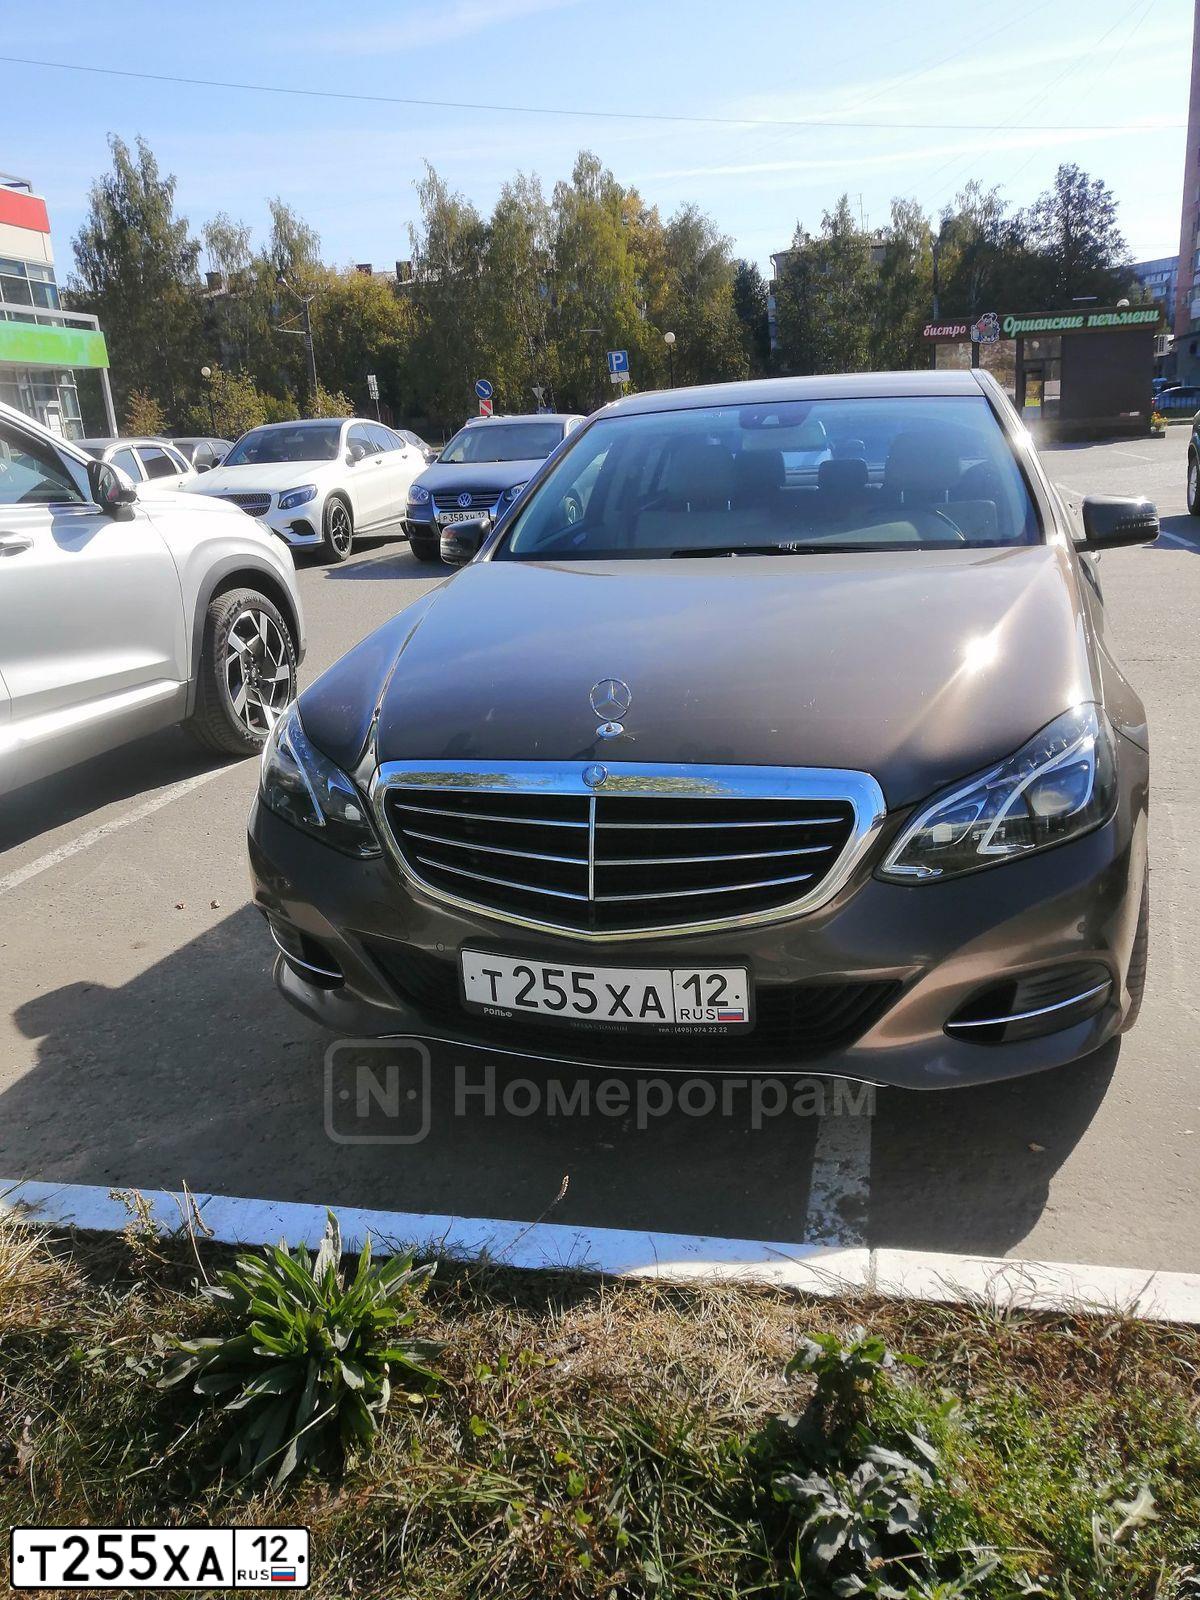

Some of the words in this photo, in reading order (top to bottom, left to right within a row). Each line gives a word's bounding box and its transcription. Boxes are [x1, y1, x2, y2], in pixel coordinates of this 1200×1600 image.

[923, 322, 967, 338] бистро
[1003, 315, 1083, 338] Оршанские
[1087, 308, 1160, 327] пельмени
[481, 965, 667, 1019] Т255ХА
[681, 973, 729, 1007] 12
[483, 1007, 513, 1018] РОЛЬФ
[680, 1009, 716, 1021] RUS
